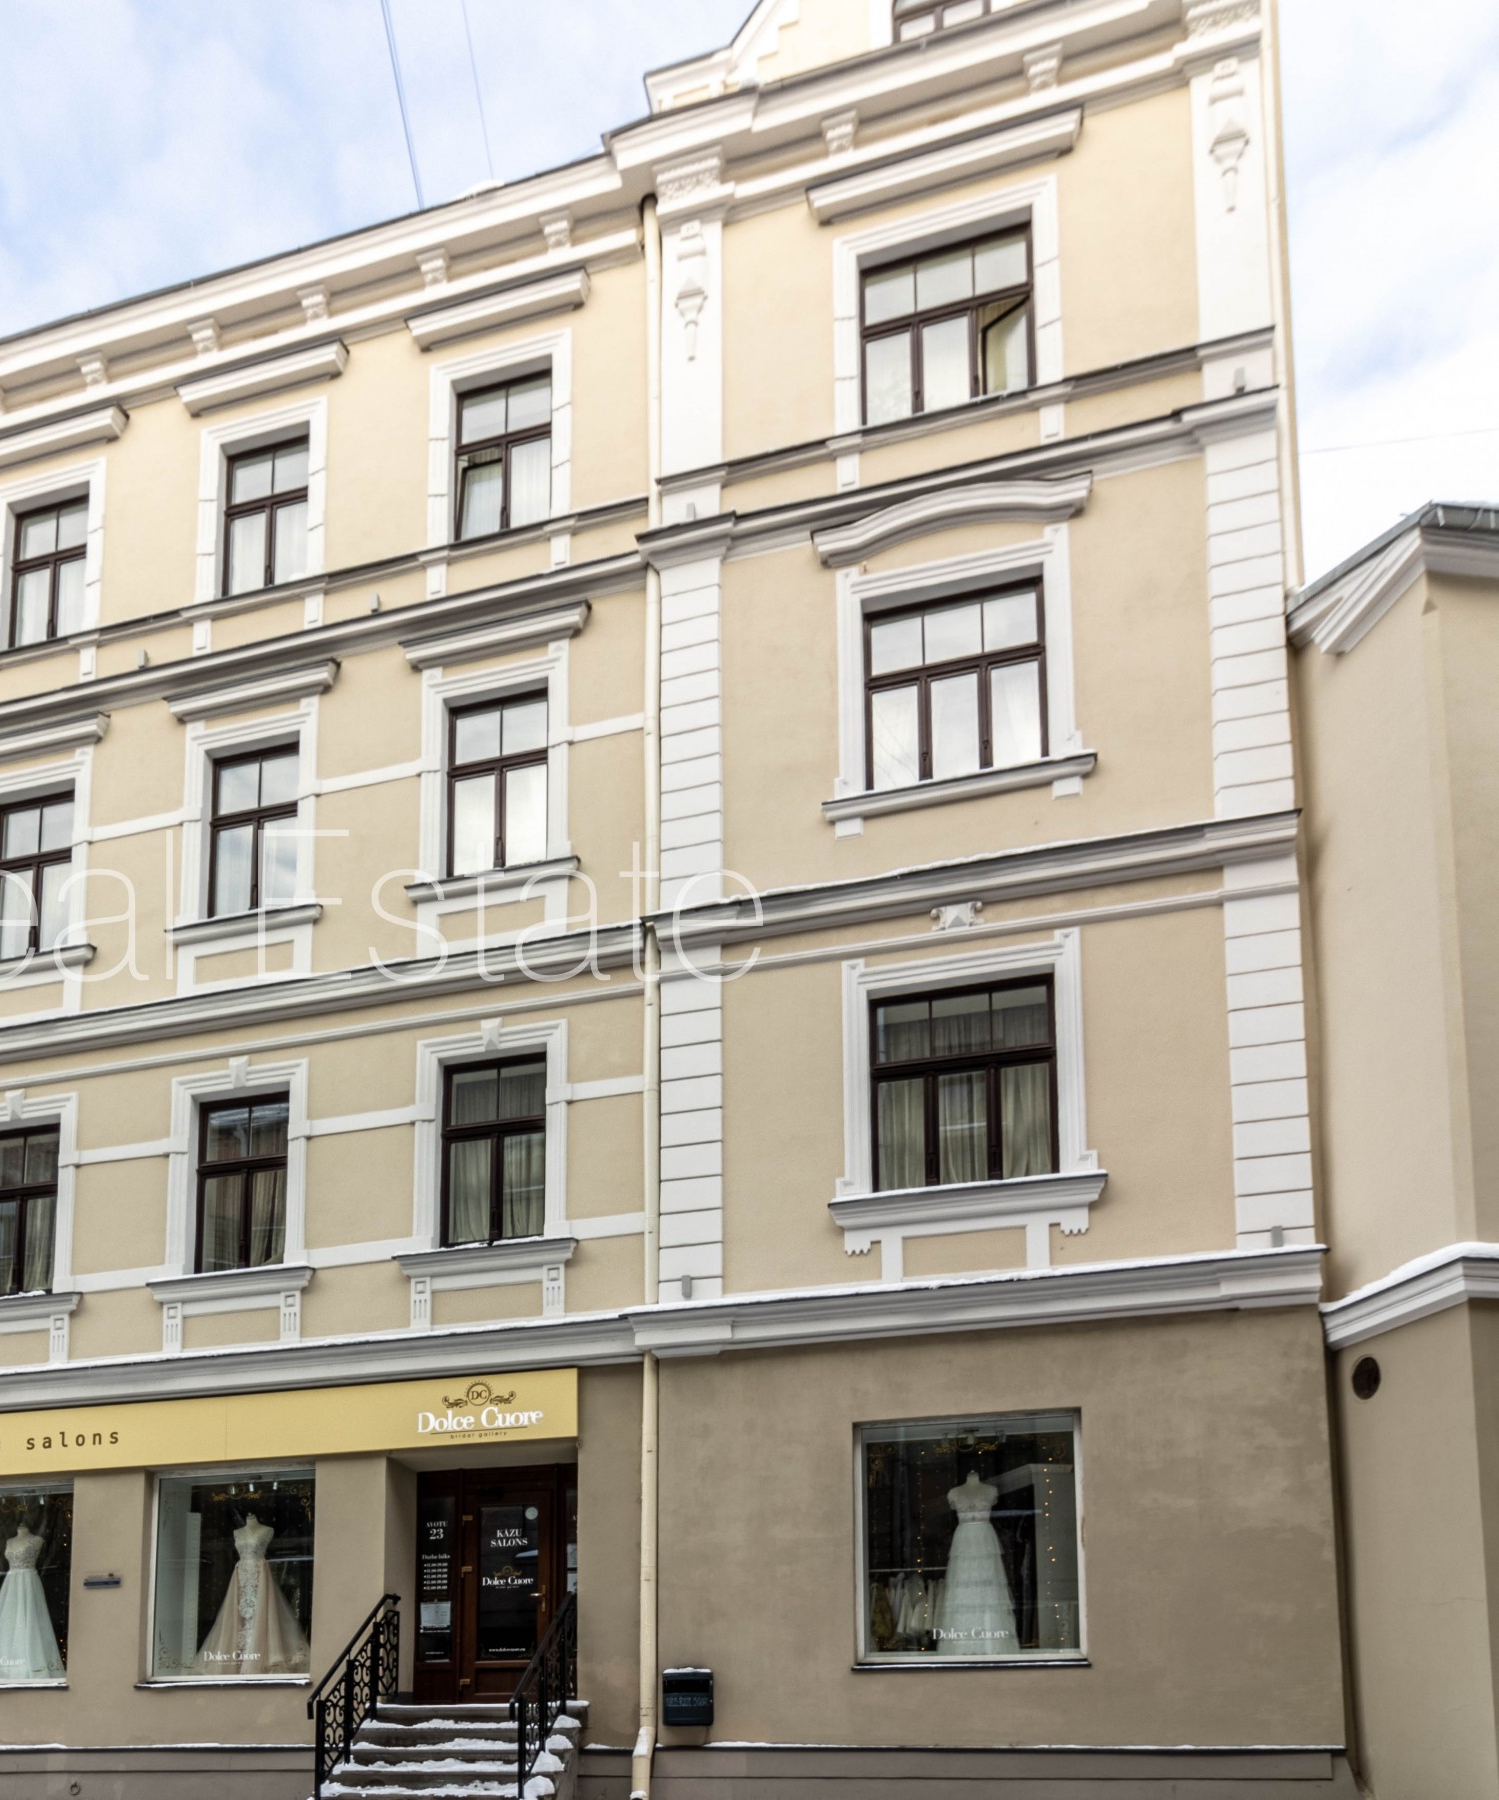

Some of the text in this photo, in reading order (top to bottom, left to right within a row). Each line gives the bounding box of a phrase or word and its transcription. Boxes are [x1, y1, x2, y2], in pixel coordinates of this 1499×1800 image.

[417, 1406, 544, 1432] Dolce Cuore
[26, 1432, 120, 1450] salons
[429, 1528, 444, 1540] 23
[490, 1538, 528, 1548] SALONS
[482, 1576, 534, 1586] Dolce Cuore
[932, 1627, 1009, 1640] Dolce Cuore
[204, 1651, 261, 1661] Dolce Cuore
